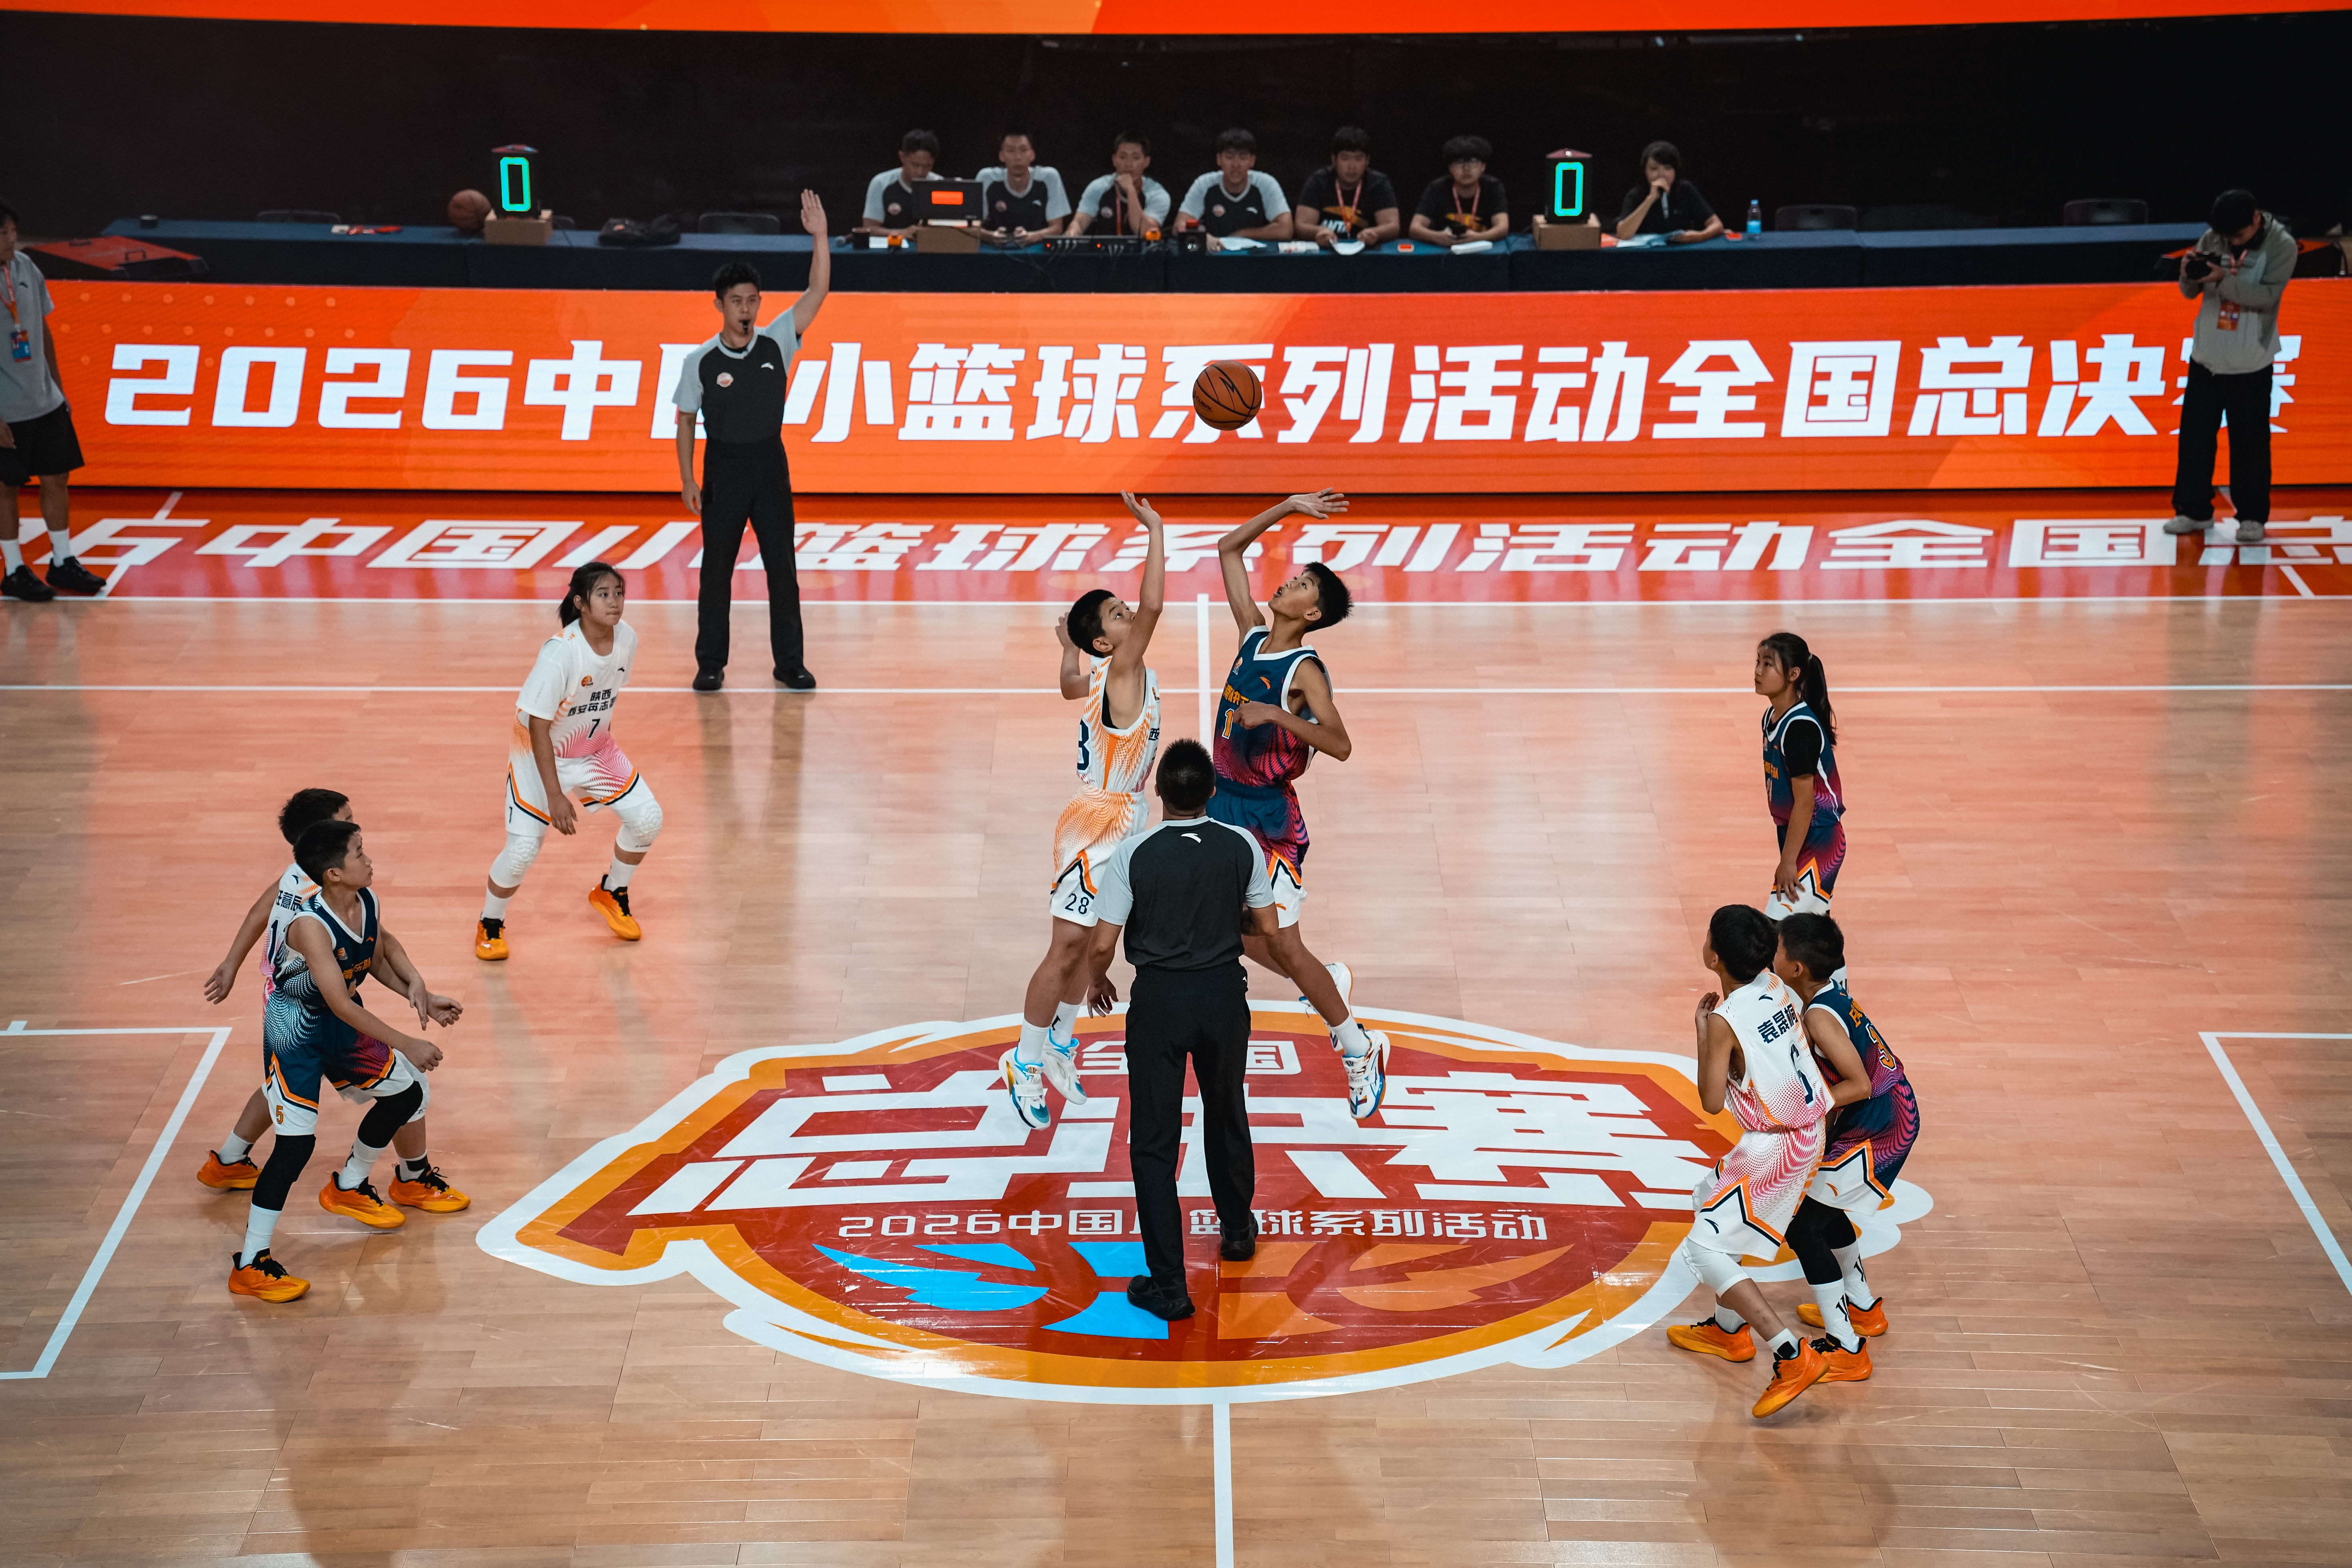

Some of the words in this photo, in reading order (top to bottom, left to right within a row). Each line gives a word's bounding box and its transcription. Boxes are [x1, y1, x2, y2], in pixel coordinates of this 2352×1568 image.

[500, 156, 532, 212] 0
[1554, 162, 1584, 216] 0
[104, 333, 2302, 443] 2026中小篮球系列活动全国总决
[590, 688, 612, 702] 陕西
[588, 718, 600, 738] 7
[1064, 893, 1089, 915] 28
[276, 1105, 283, 1124] 5
[838, 1209, 1547, 1240] 2026中国篮球系列活动
